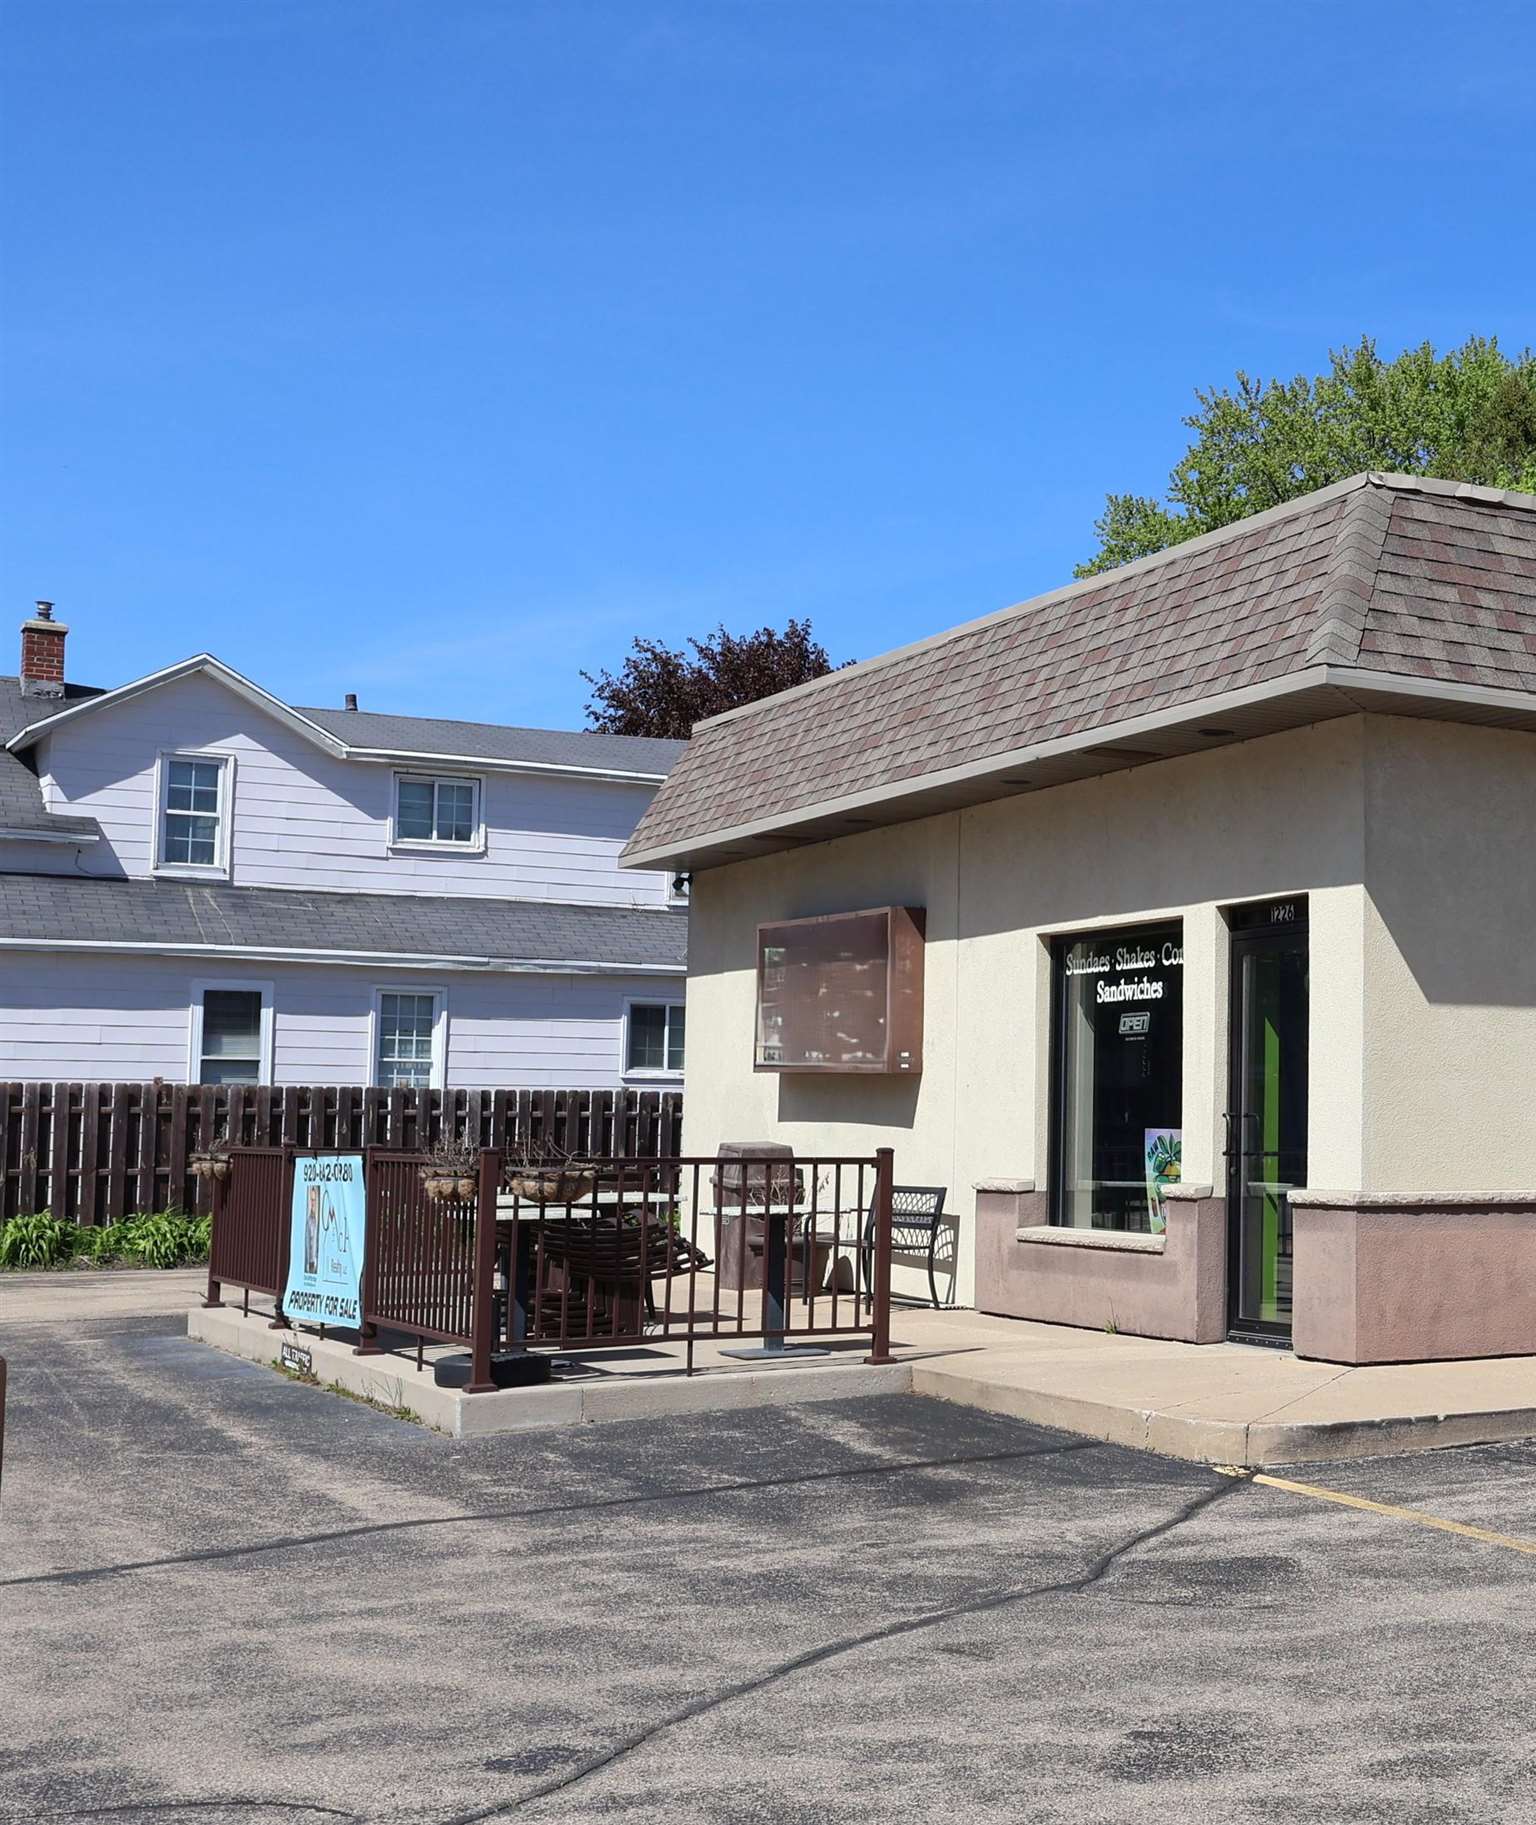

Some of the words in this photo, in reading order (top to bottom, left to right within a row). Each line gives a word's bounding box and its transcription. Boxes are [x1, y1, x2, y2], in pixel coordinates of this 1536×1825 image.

[1066, 952, 1111, 975] Sundaes
[1115, 946, 1155, 971] Shakes
[1096, 976, 1163, 1003] Sandwiches
[1120, 1015, 1148, 1031] OPEN
[288, 1290, 325, 1314] PROPERTY
[325, 1295, 339, 1317] FOR
[339, 1298, 358, 1320] SALE
